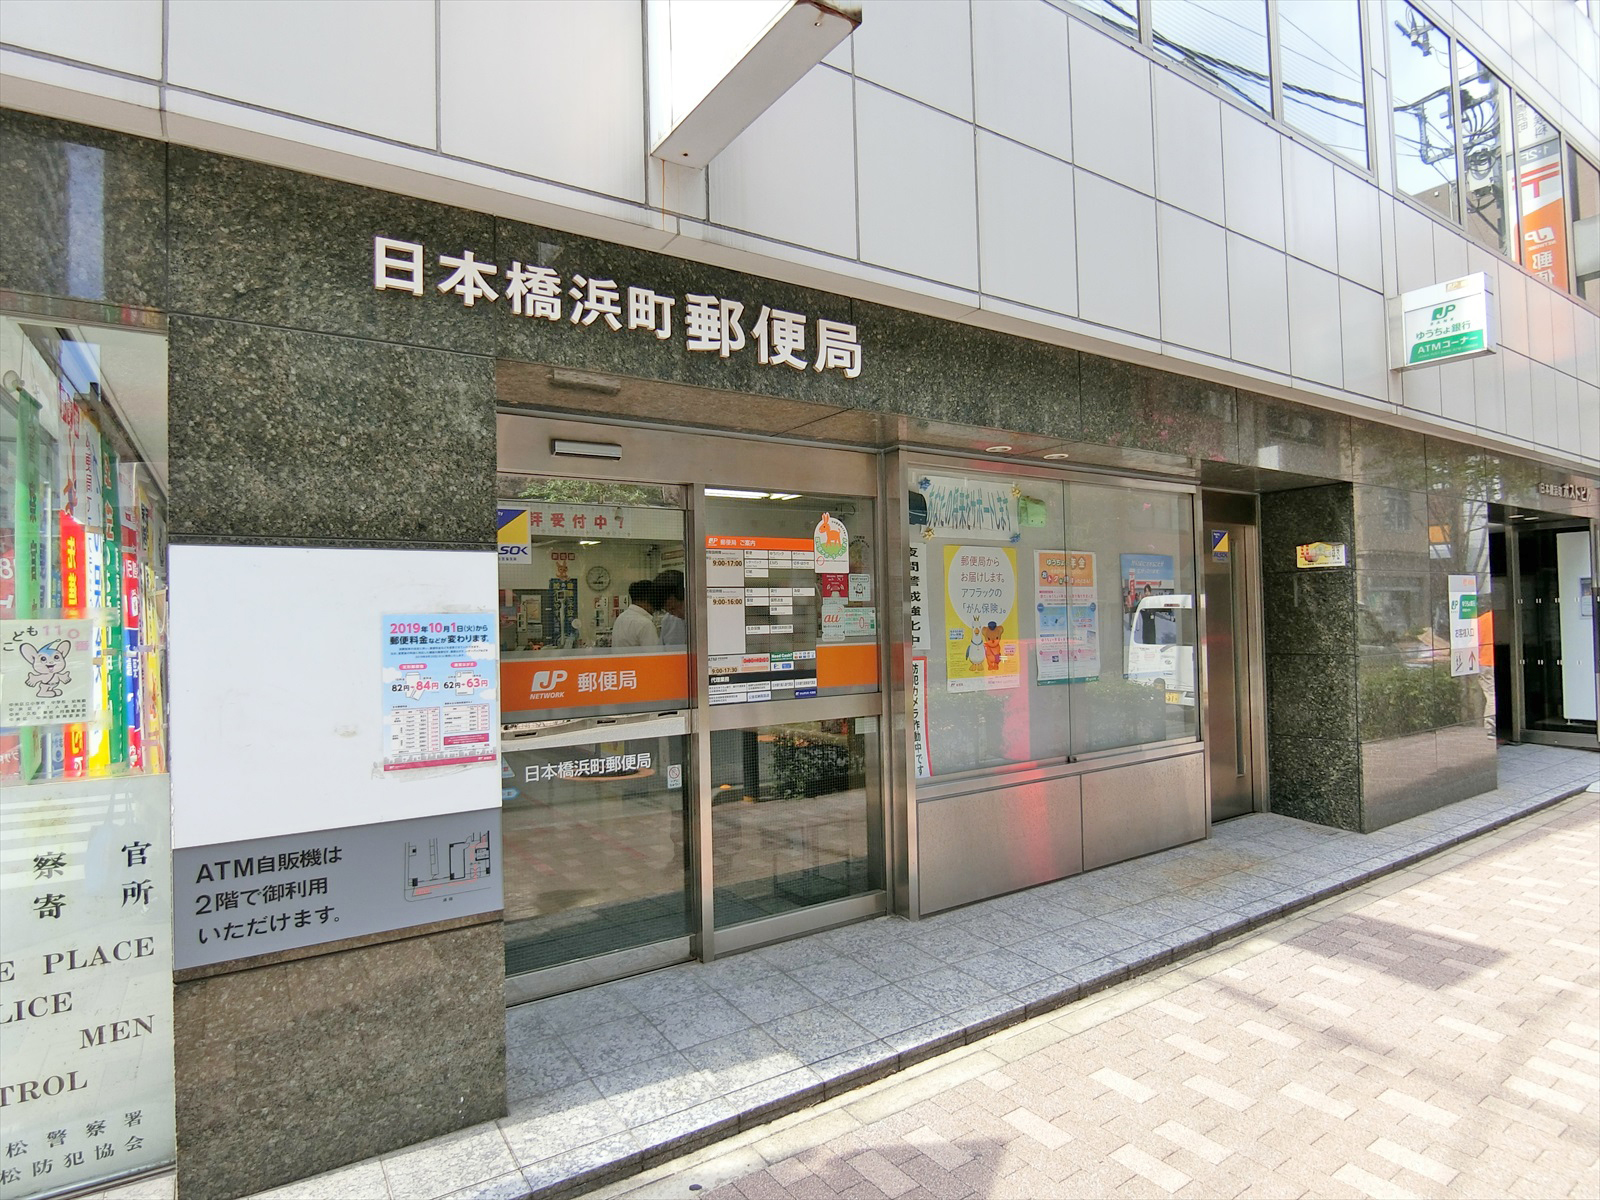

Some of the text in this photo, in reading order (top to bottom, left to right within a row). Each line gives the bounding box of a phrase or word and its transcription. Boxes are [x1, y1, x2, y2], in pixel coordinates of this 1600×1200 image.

[374, 236, 863, 379] 日本橋浜町郵便局
[1416, 320, 1471, 340] ゆうちょ銀行
[1417, 336, 1479, 354] ATMコーナー
[498, 545, 528, 556] SOK
[740, 539, 756, 547] ご案内
[961, 555, 1000, 567] 郵便局から
[1046, 555, 1087, 570] ゆうちょ年金
[960, 572, 1005, 583] お届けします。
[961, 587, 1003, 598] アフラックの
[962, 603, 1007, 614] 「がん保険」。
[823, 614, 841, 623] au
[390, 622, 488, 634] 2019年10月1日(火)から
[389, 634, 489, 645] 郵便料金などが変わります。
[391, 680, 439, 692] 82円 84円
[443, 678, 488, 689] 62円 63円
[531, 670, 568, 692] JP
[577, 670, 637, 693] 郵便局
[530, 691, 565, 700] NETWORK
[525, 752, 651, 783] 日本橋浜町郵便局
[195, 846, 343, 883] ATM自販機は
[195, 876, 329, 915] 2階で御利用
[198, 904, 341, 944] いただけます。
[43, 936, 155, 976] PLACE
[79, 1014, 155, 1050] MEN
[5, 1109, 144, 1159] 松警察署
[0, 1134, 144, 1186] 松防犯協会
